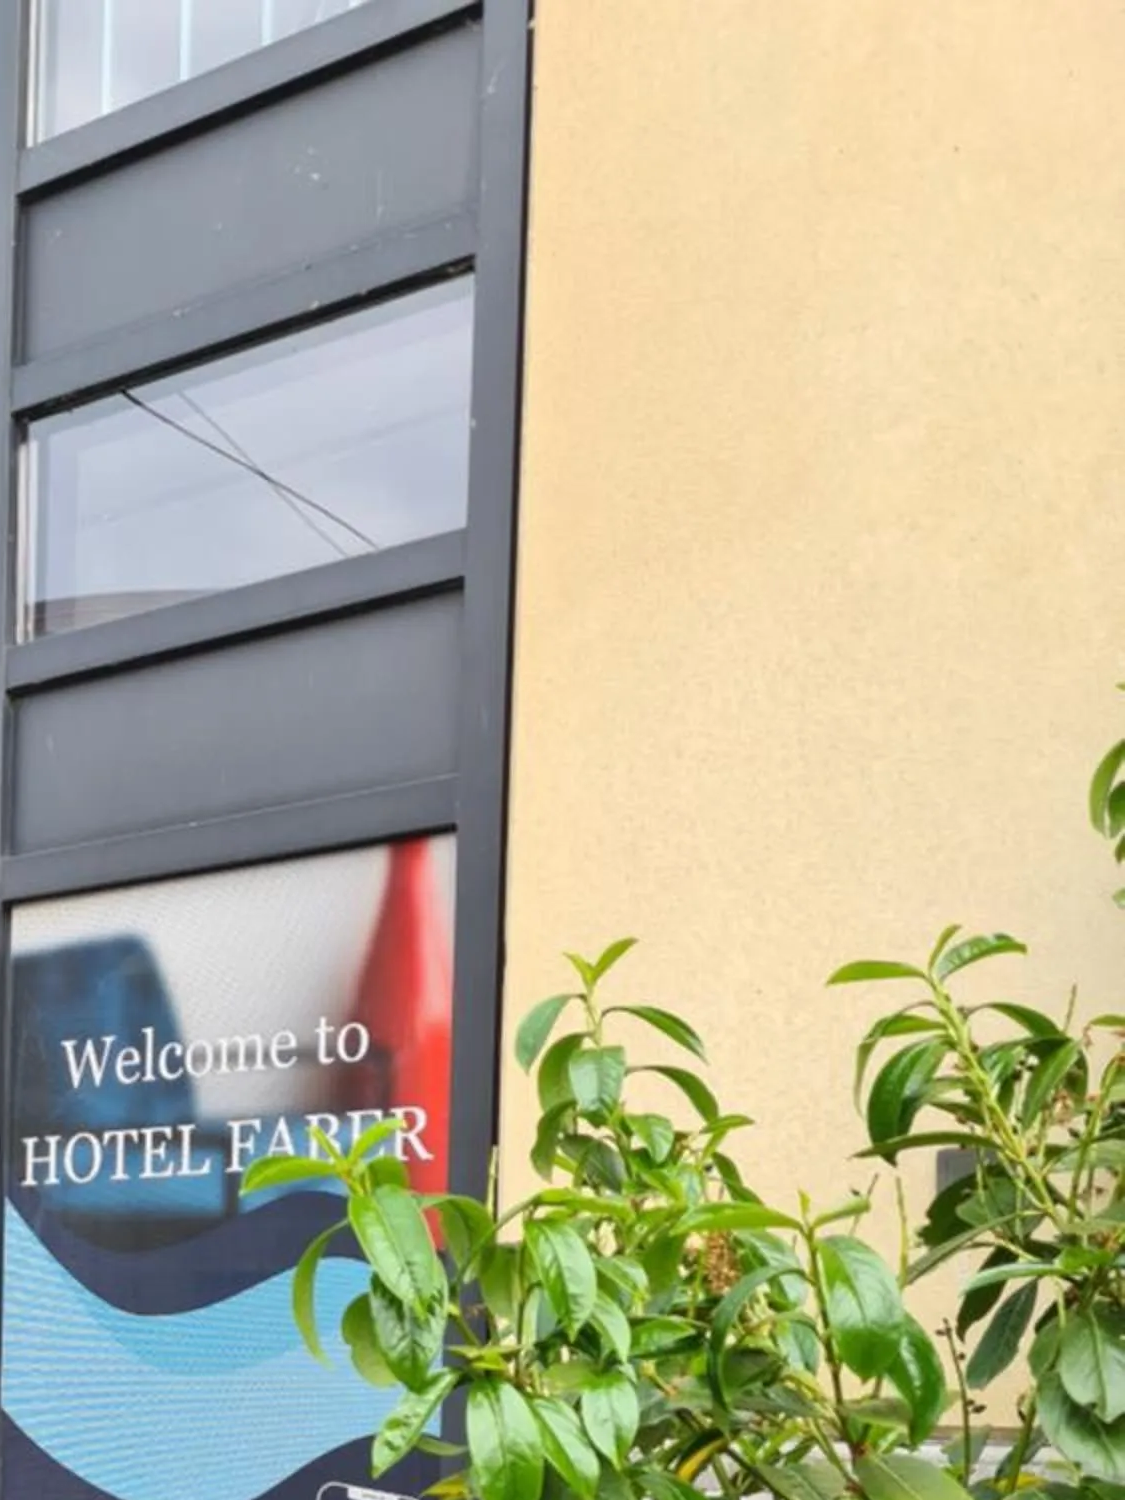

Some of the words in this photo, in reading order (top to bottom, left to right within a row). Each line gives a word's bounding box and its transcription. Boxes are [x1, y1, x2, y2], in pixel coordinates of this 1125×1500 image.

[61, 1027, 297, 1089] Welcome
[315, 1015, 370, 1065] to
[20, 1123, 212, 1187] HOTEL
[224, 1105, 434, 1175] FABER
